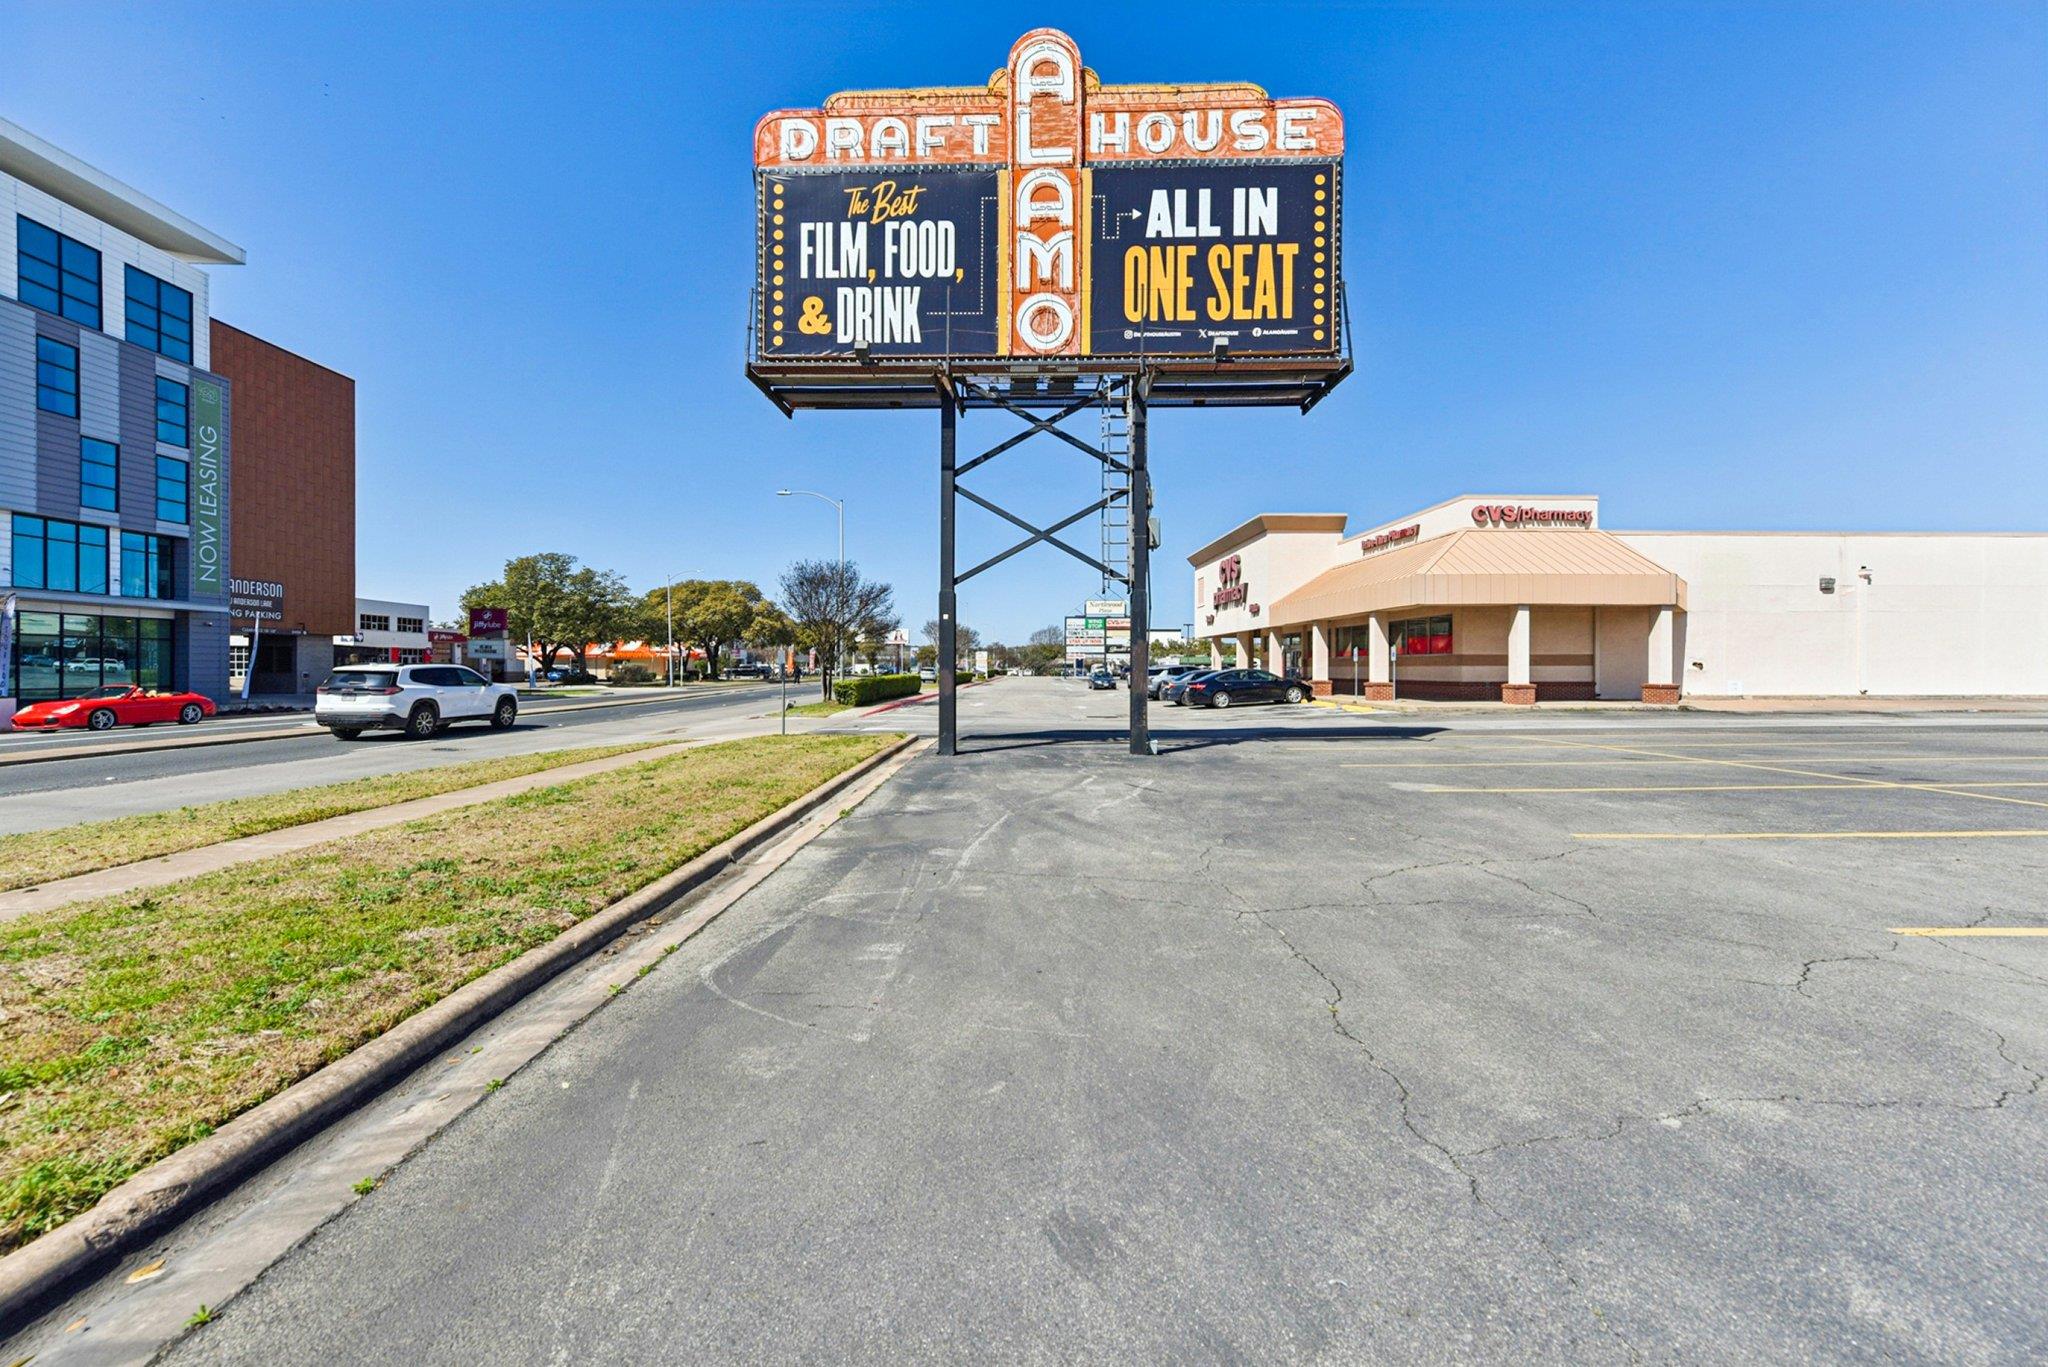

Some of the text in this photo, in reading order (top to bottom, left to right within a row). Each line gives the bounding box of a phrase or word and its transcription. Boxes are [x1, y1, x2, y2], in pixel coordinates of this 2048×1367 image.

[779, 107, 1318, 160] DRAFT HOUSE
[843, 180, 928, 225] The Best
[1015, 42, 1075, 352] ALAMO
[1145, 187, 1278, 238] ALL IN
[800, 219, 964, 284] FILM, FOOD,
[1124, 243, 1299, 323] ONE SEAT
[798, 286, 921, 344] & DRINK
[199, 425, 217, 582] NOW LEASING
